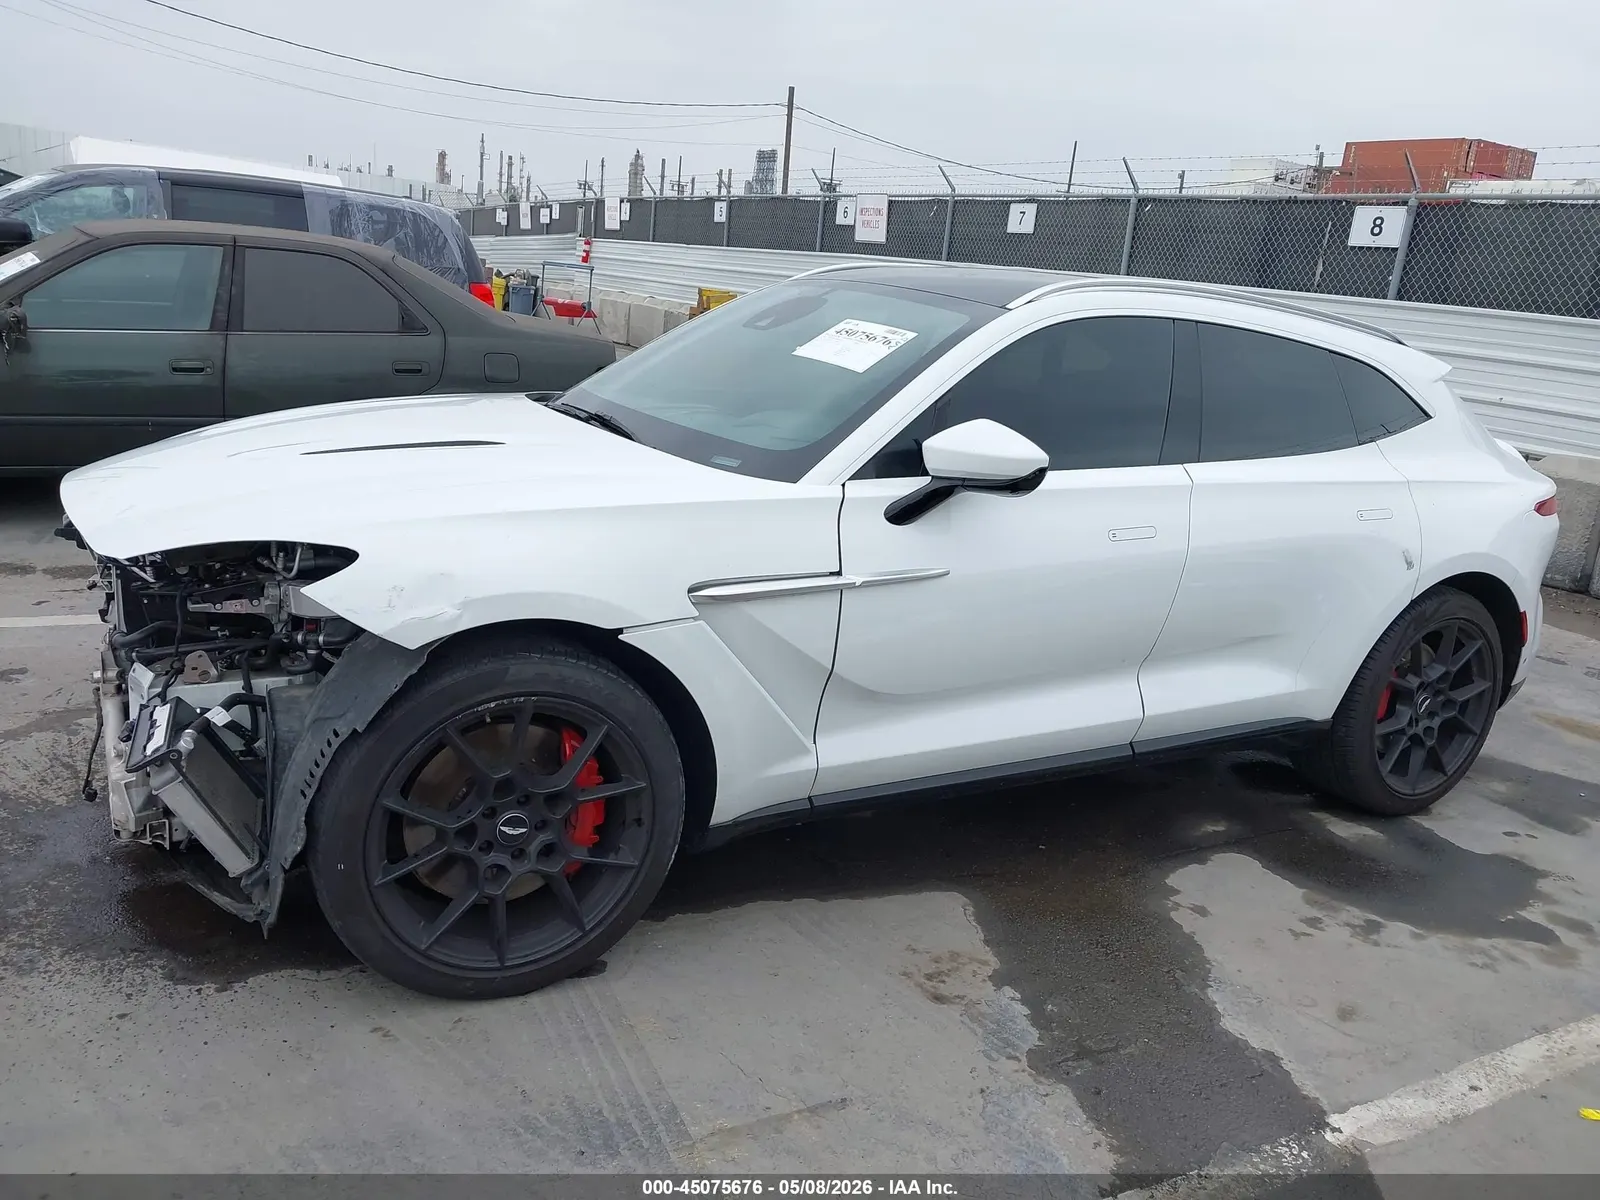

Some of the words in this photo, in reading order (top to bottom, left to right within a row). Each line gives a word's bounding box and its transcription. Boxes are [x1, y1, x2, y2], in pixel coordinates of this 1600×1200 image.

[843, 206, 849, 219] 6
[1018, 211, 1027, 226] 7
[1369, 215, 1385, 237] 8
